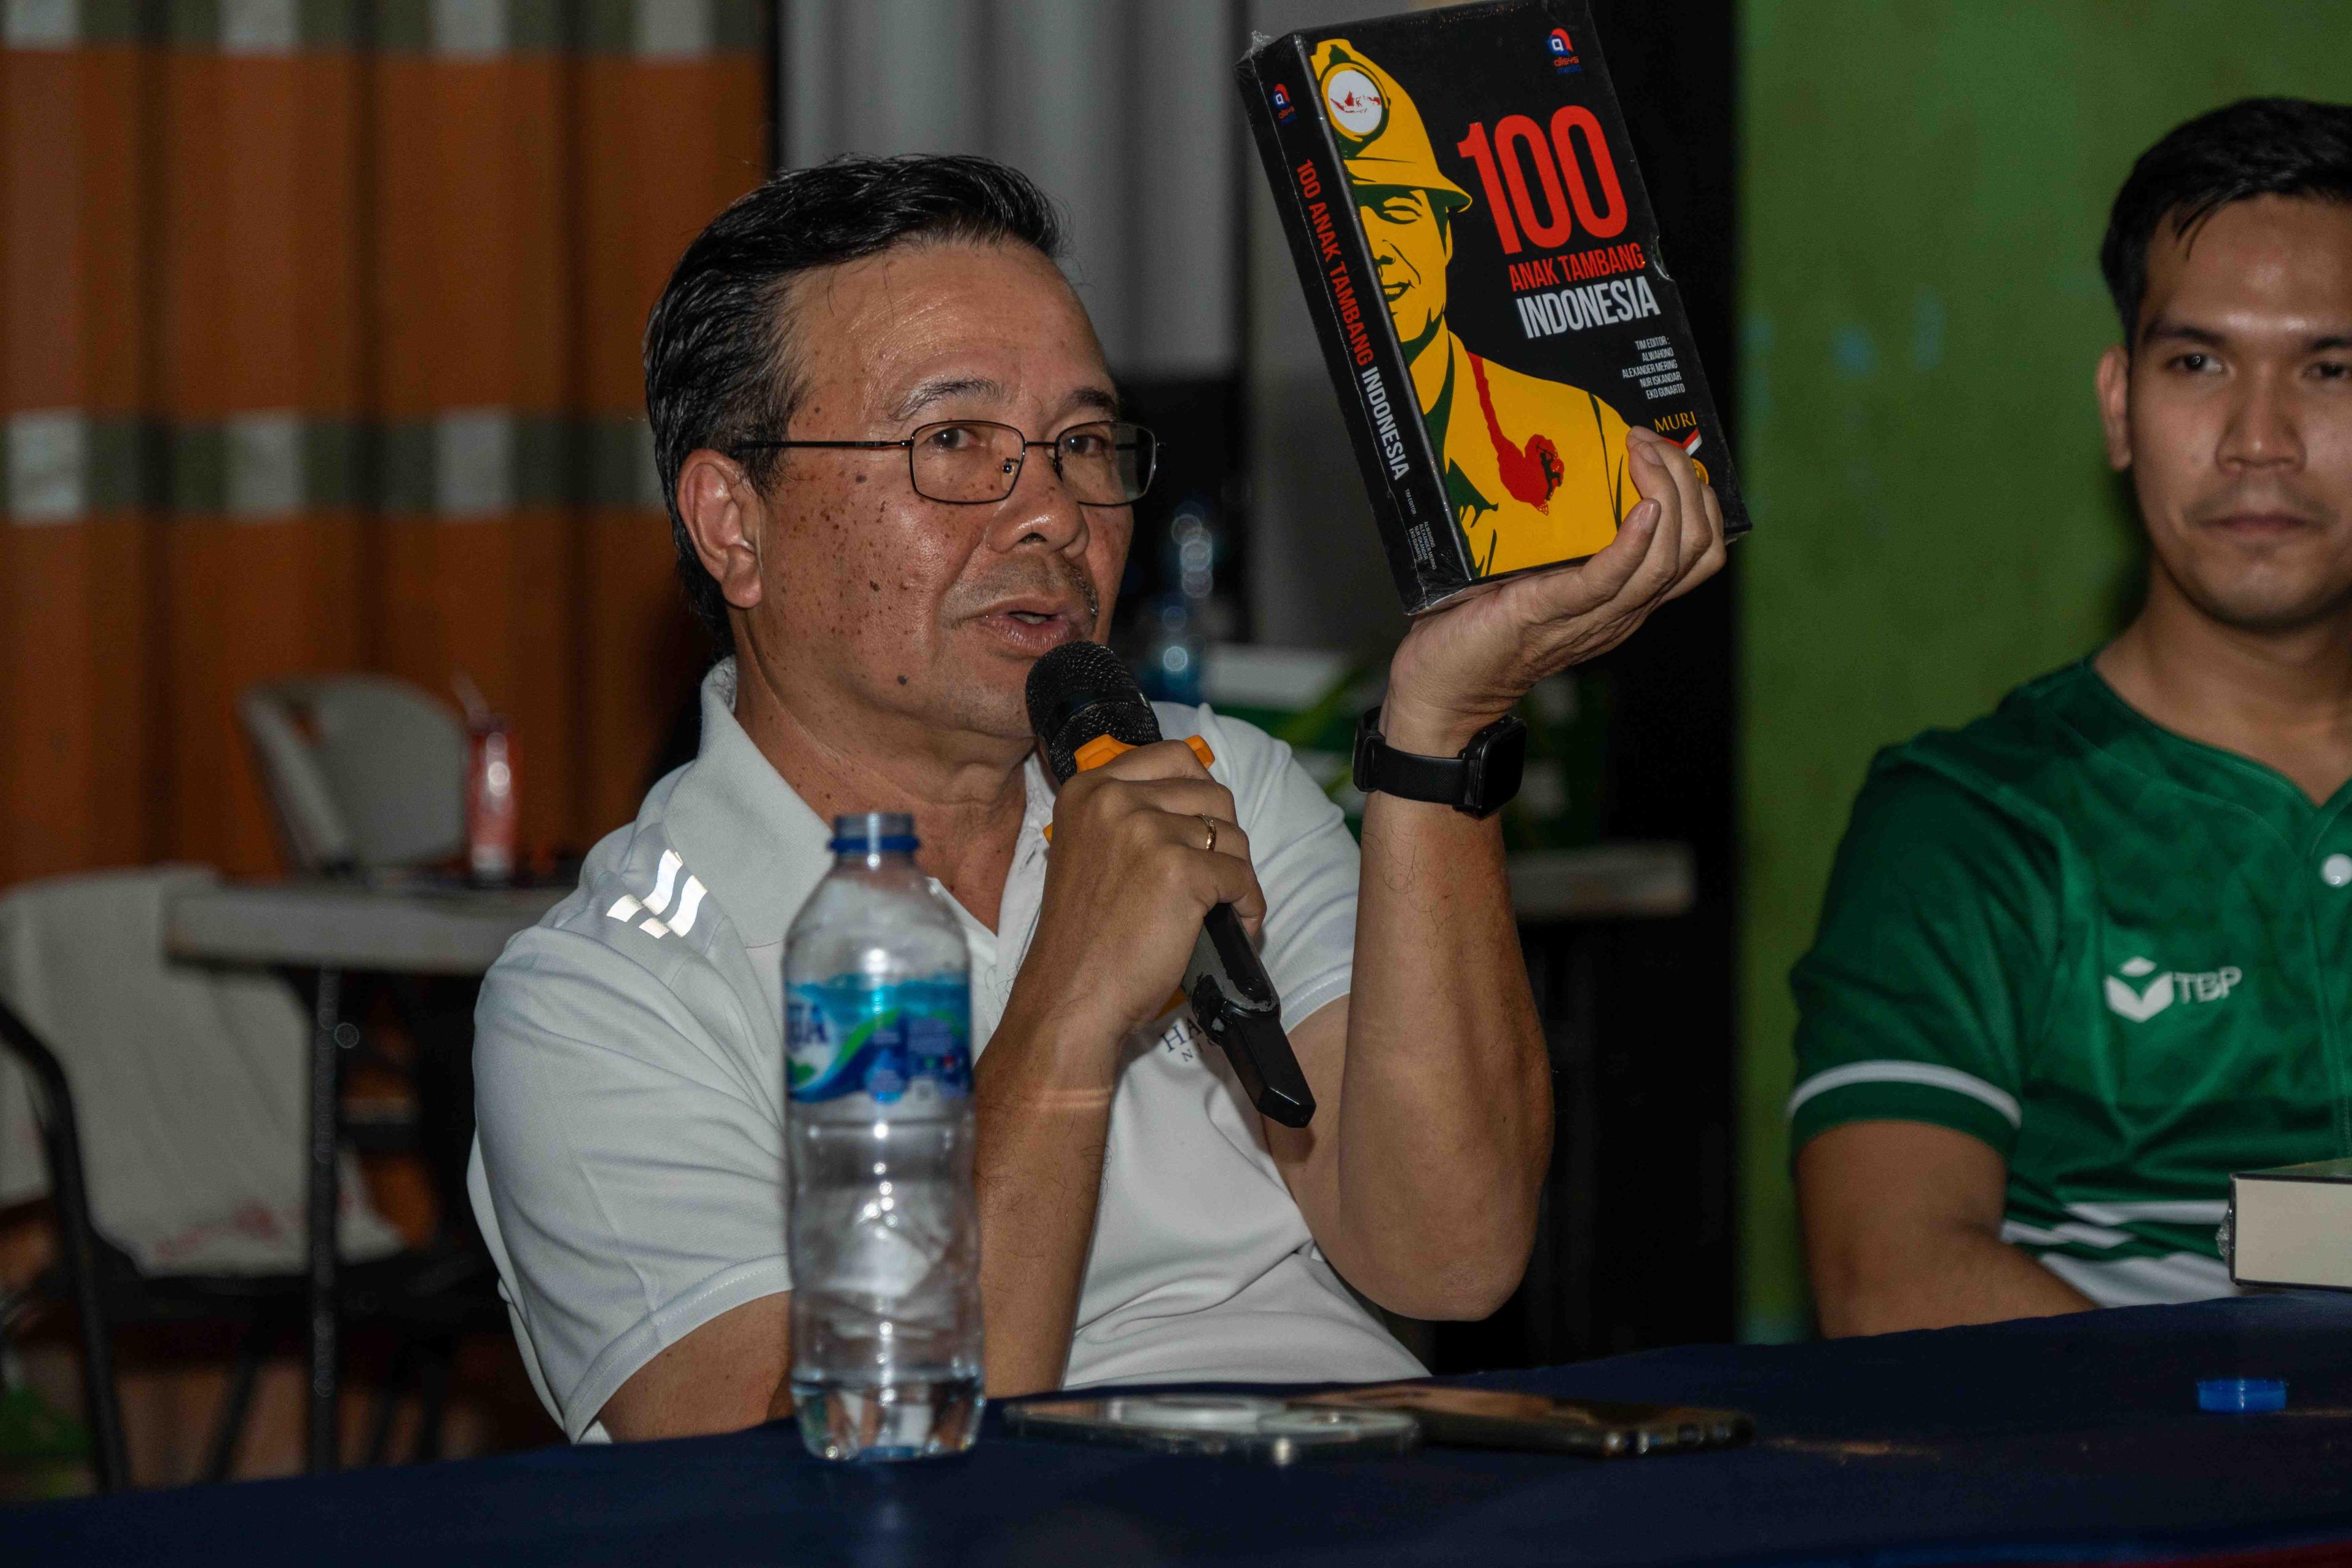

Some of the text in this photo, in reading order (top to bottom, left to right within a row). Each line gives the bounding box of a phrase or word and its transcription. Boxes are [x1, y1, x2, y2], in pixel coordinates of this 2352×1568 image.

[1457, 105, 1628, 255] 100
[1509, 243, 1646, 292] ANAK TAMBANG
[1516, 276, 1661, 338] INDONESIA
[1296, 159, 1409, 481] 100 ANAK TAMBANG INDONESIA
[1635, 339, 1647, 350] TIM
[1642, 347, 1674, 362] ALWAHONO
[1622, 359, 1678, 379] ALEXANDER MERING
[1640, 371, 1682, 388] NUR ISKANDAR
[1646, 383, 1686, 399] EKO GUNARTO
[1654, 411, 1697, 432] MURI
[1419, 524, 1431, 552] ALEXANDER
[2174, 966, 2243, 1005] TBP
